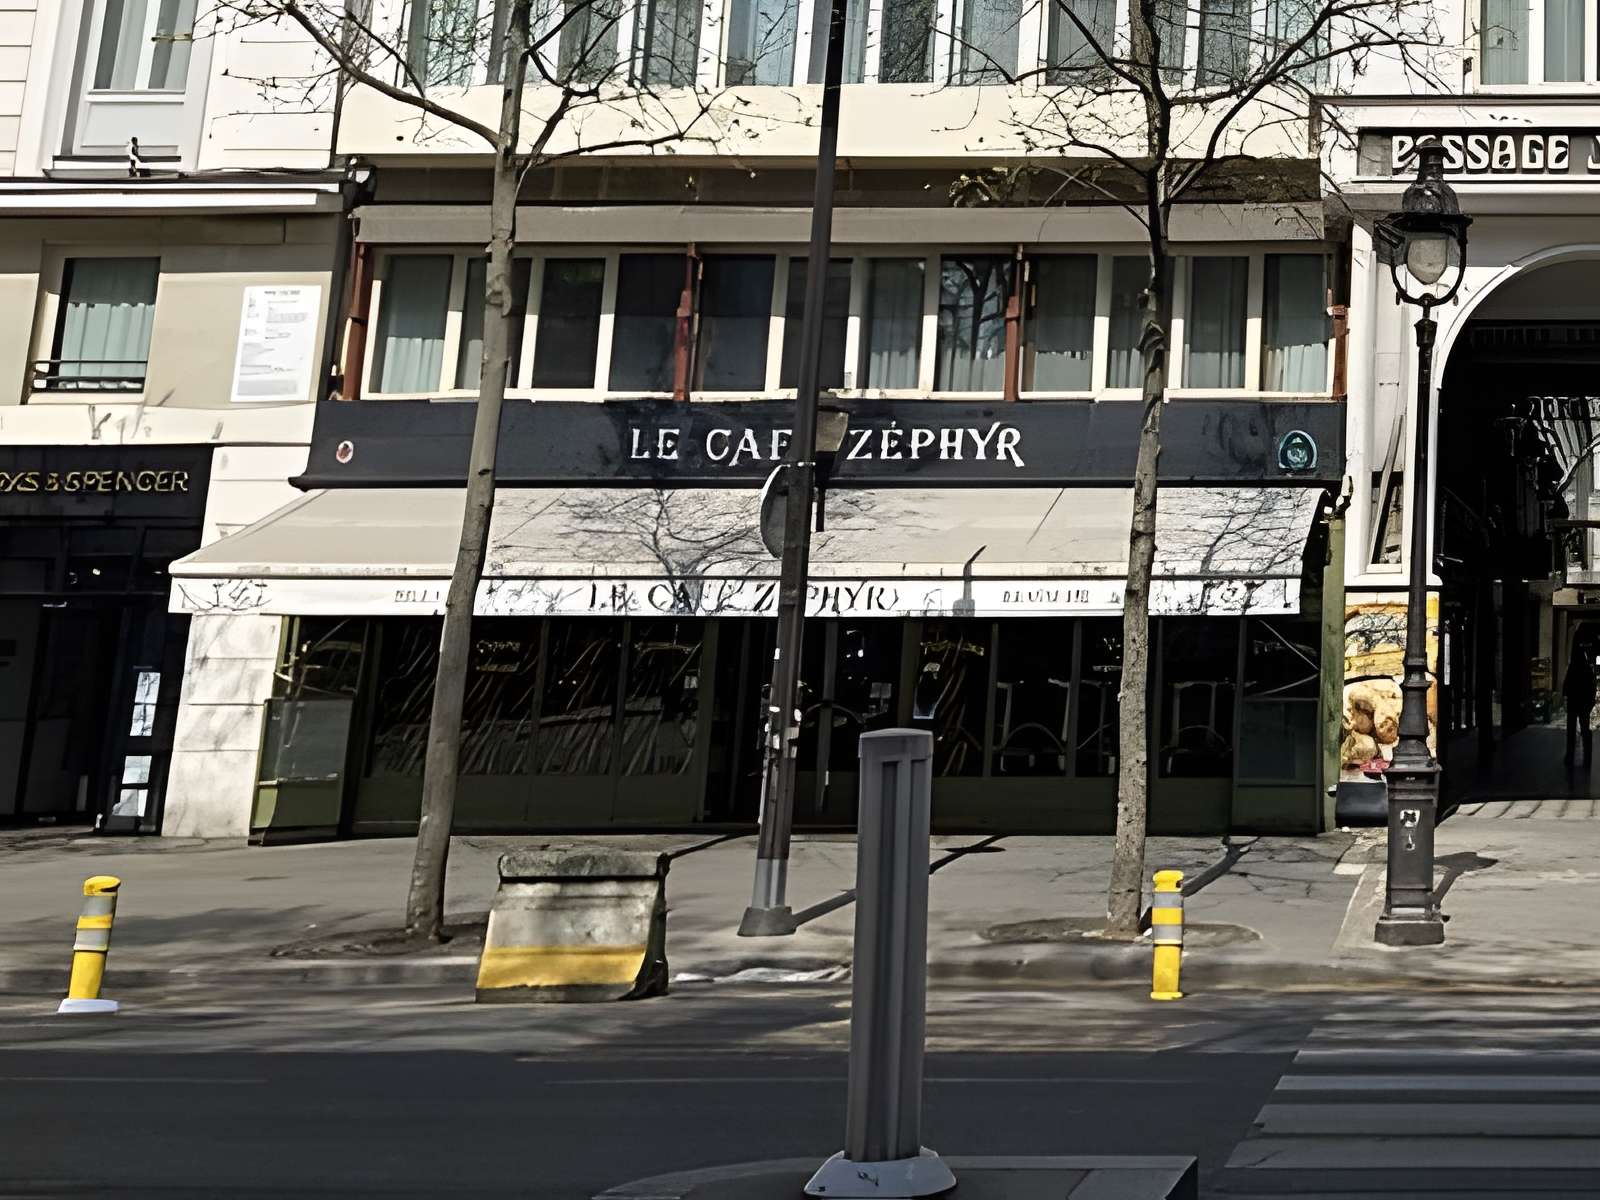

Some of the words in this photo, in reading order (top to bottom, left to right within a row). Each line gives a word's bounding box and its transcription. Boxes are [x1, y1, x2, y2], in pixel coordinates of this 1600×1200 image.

[630, 427, 681, 460] LE
[705, 427, 794, 467] CAF
[846, 420, 1026, 468] ZÉPHYR
